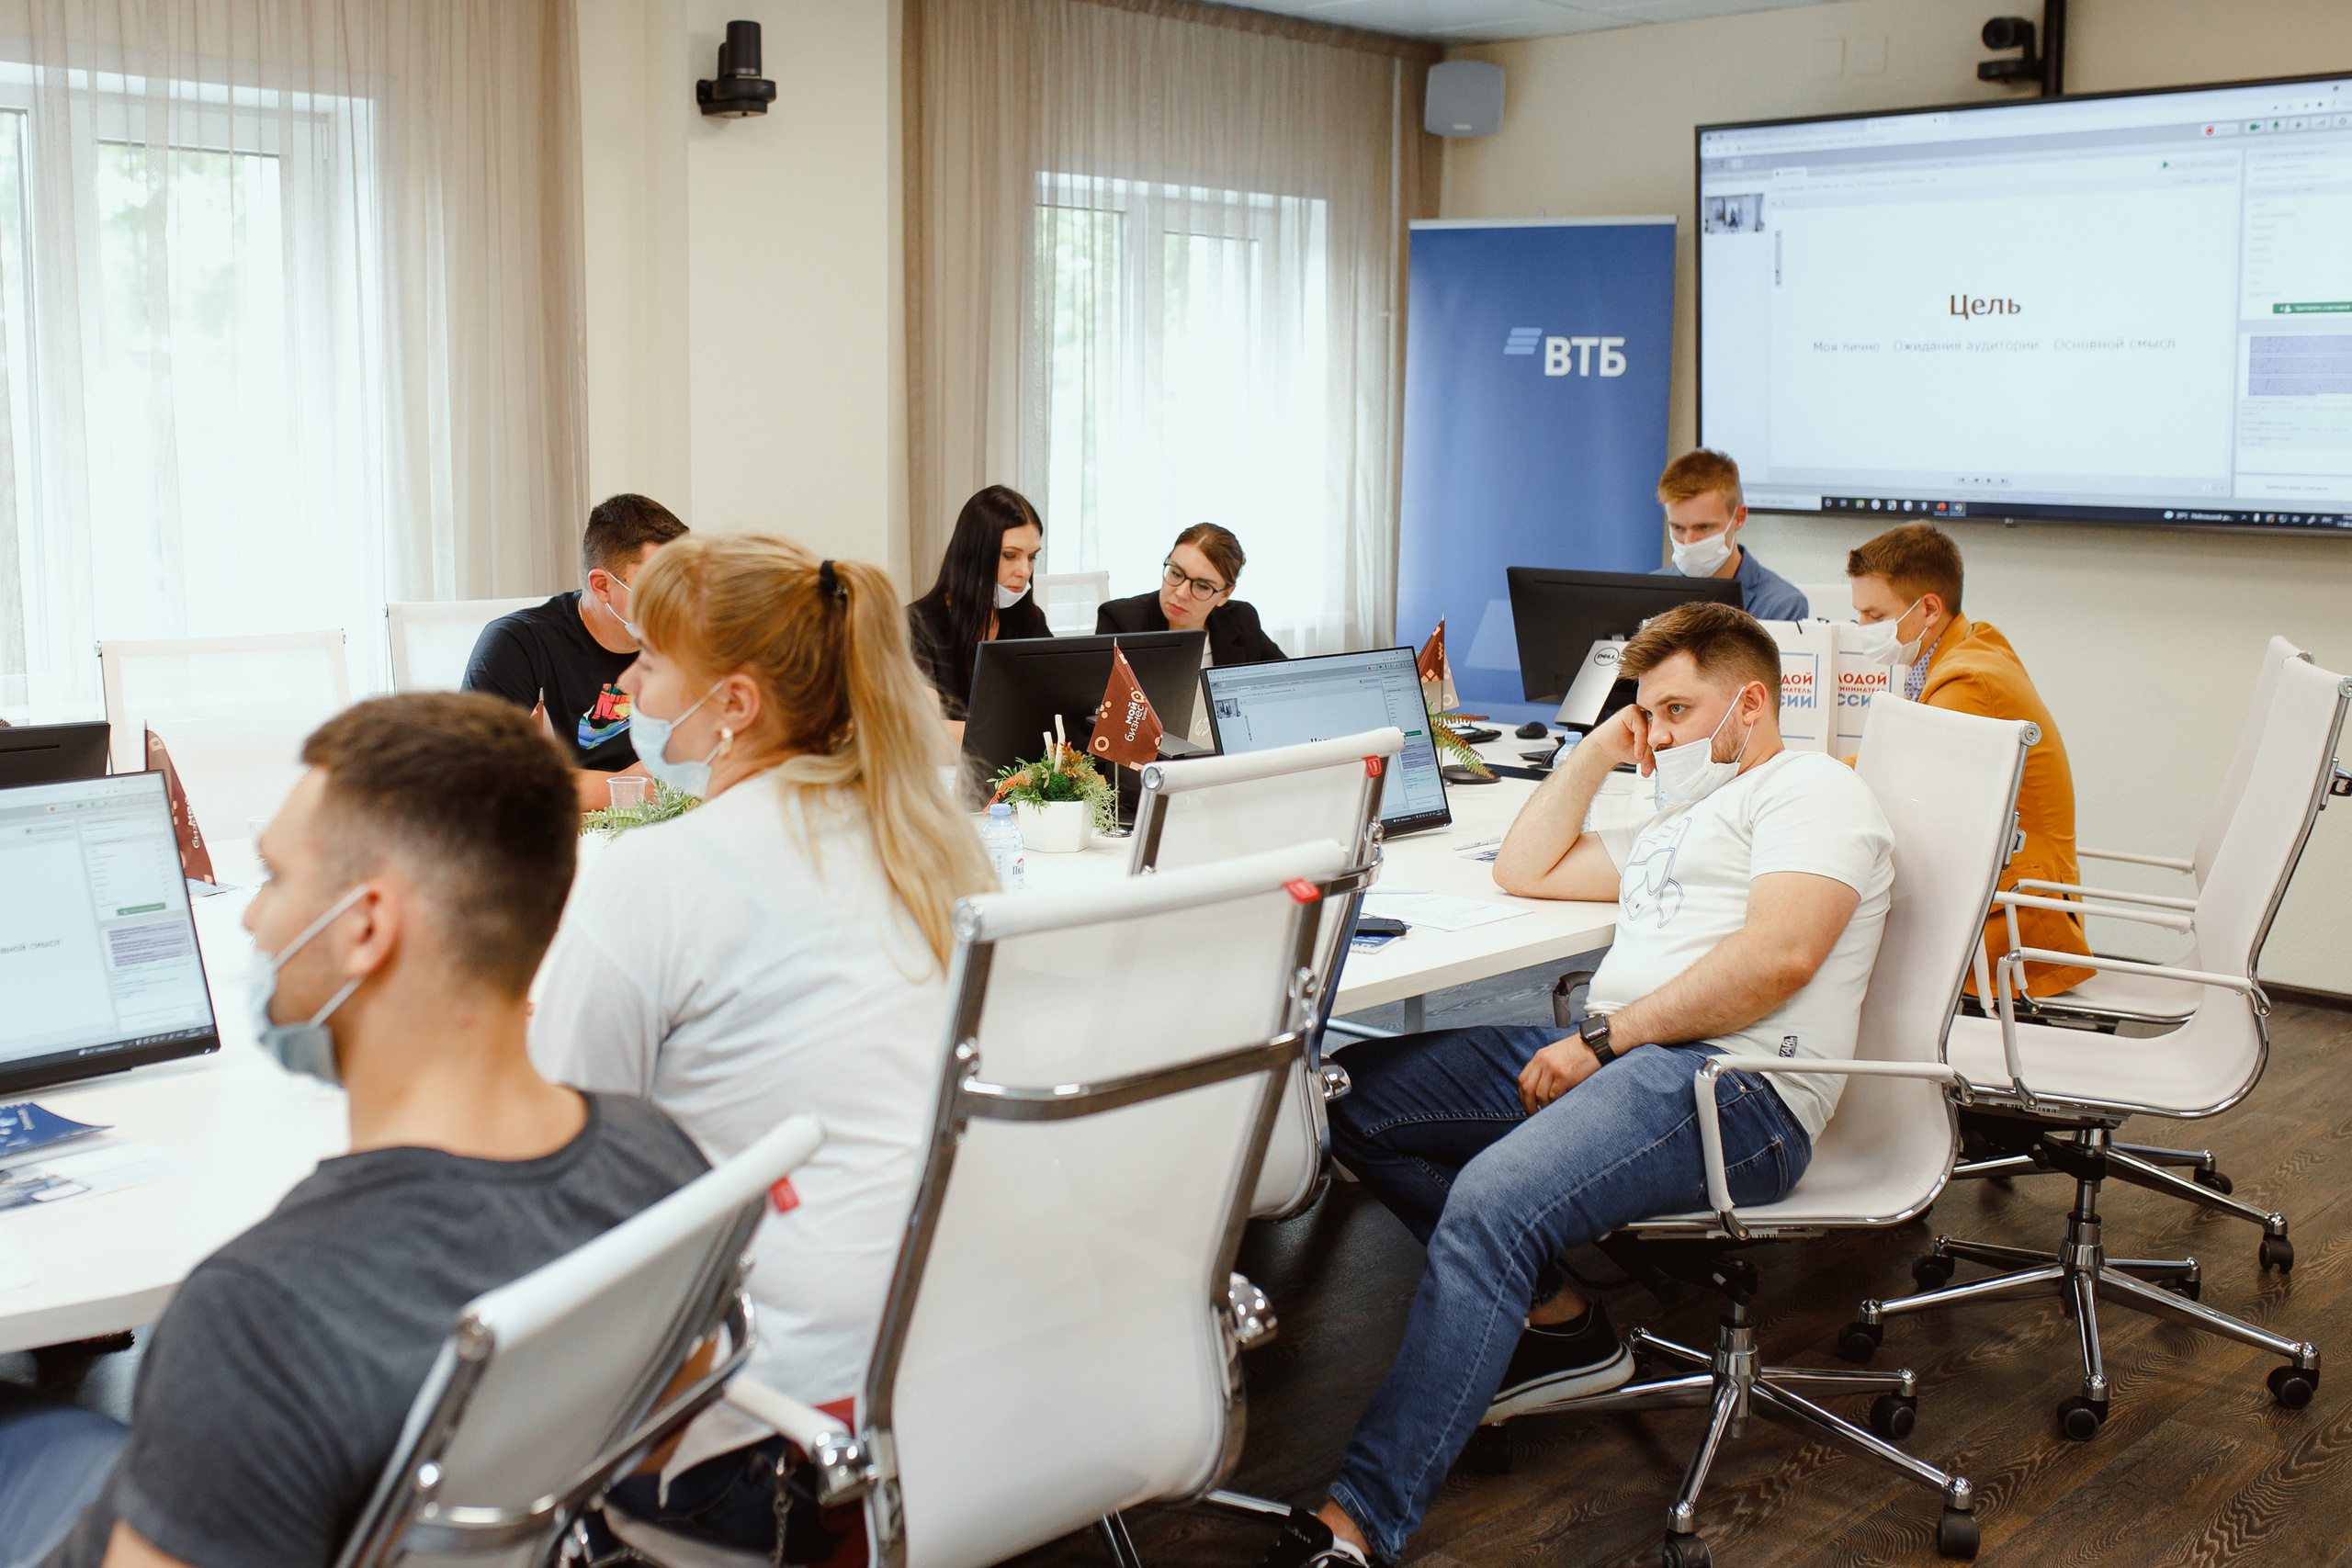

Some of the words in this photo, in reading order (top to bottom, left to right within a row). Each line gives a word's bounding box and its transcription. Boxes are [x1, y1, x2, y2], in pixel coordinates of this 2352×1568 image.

[1951, 294, 2021, 321] Цель
[1544, 335, 1627, 378] ВТБ
[1841, 343, 1881, 353] лично
[1894, 341, 1962, 353] Ожидания
[1966, 341, 2039, 354] аудитории
[2053, 337, 2125, 351] Основной
[2130, 338, 2177, 349] смысл
[1124, 704, 1145, 742] бизнес
[1125, 701, 1138, 725] мой
